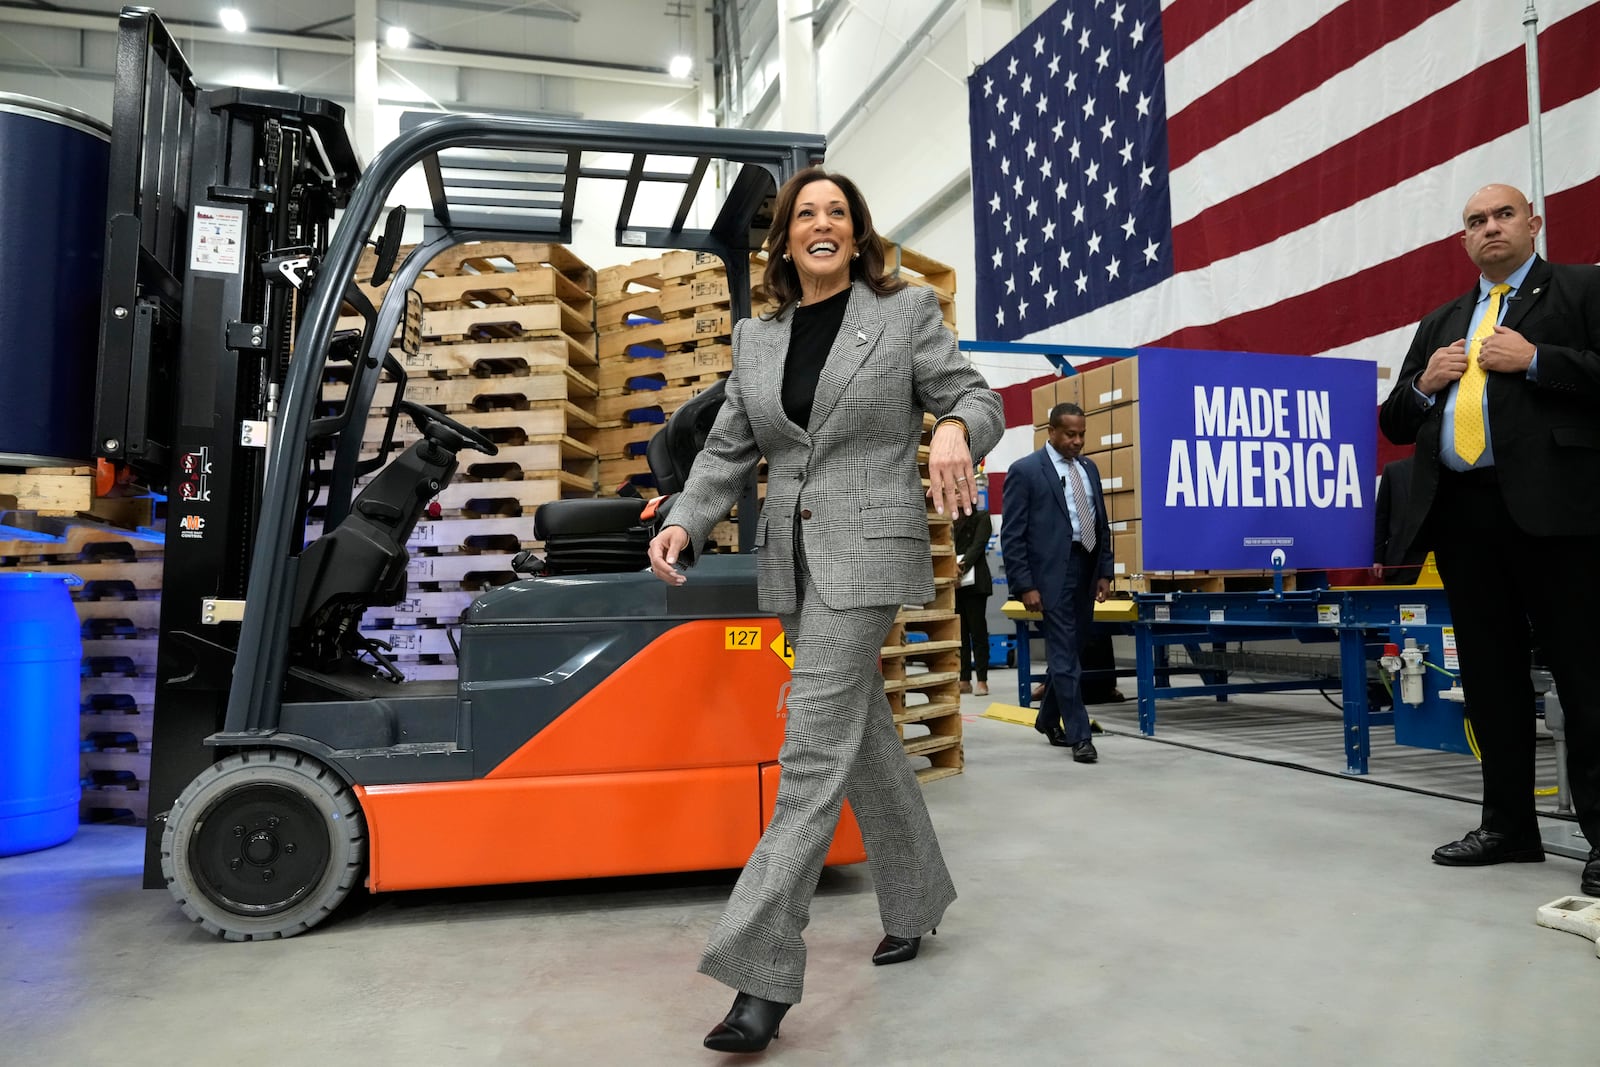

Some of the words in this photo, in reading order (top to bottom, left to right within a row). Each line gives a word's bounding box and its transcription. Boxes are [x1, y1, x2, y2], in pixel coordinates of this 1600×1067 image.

[1194, 385, 1290, 438] MADE
[1297, 390, 1331, 440] IN
[1165, 439, 1363, 508] AMERICA
[180, 515, 205, 530] AMC
[728, 631, 758, 646] 127
